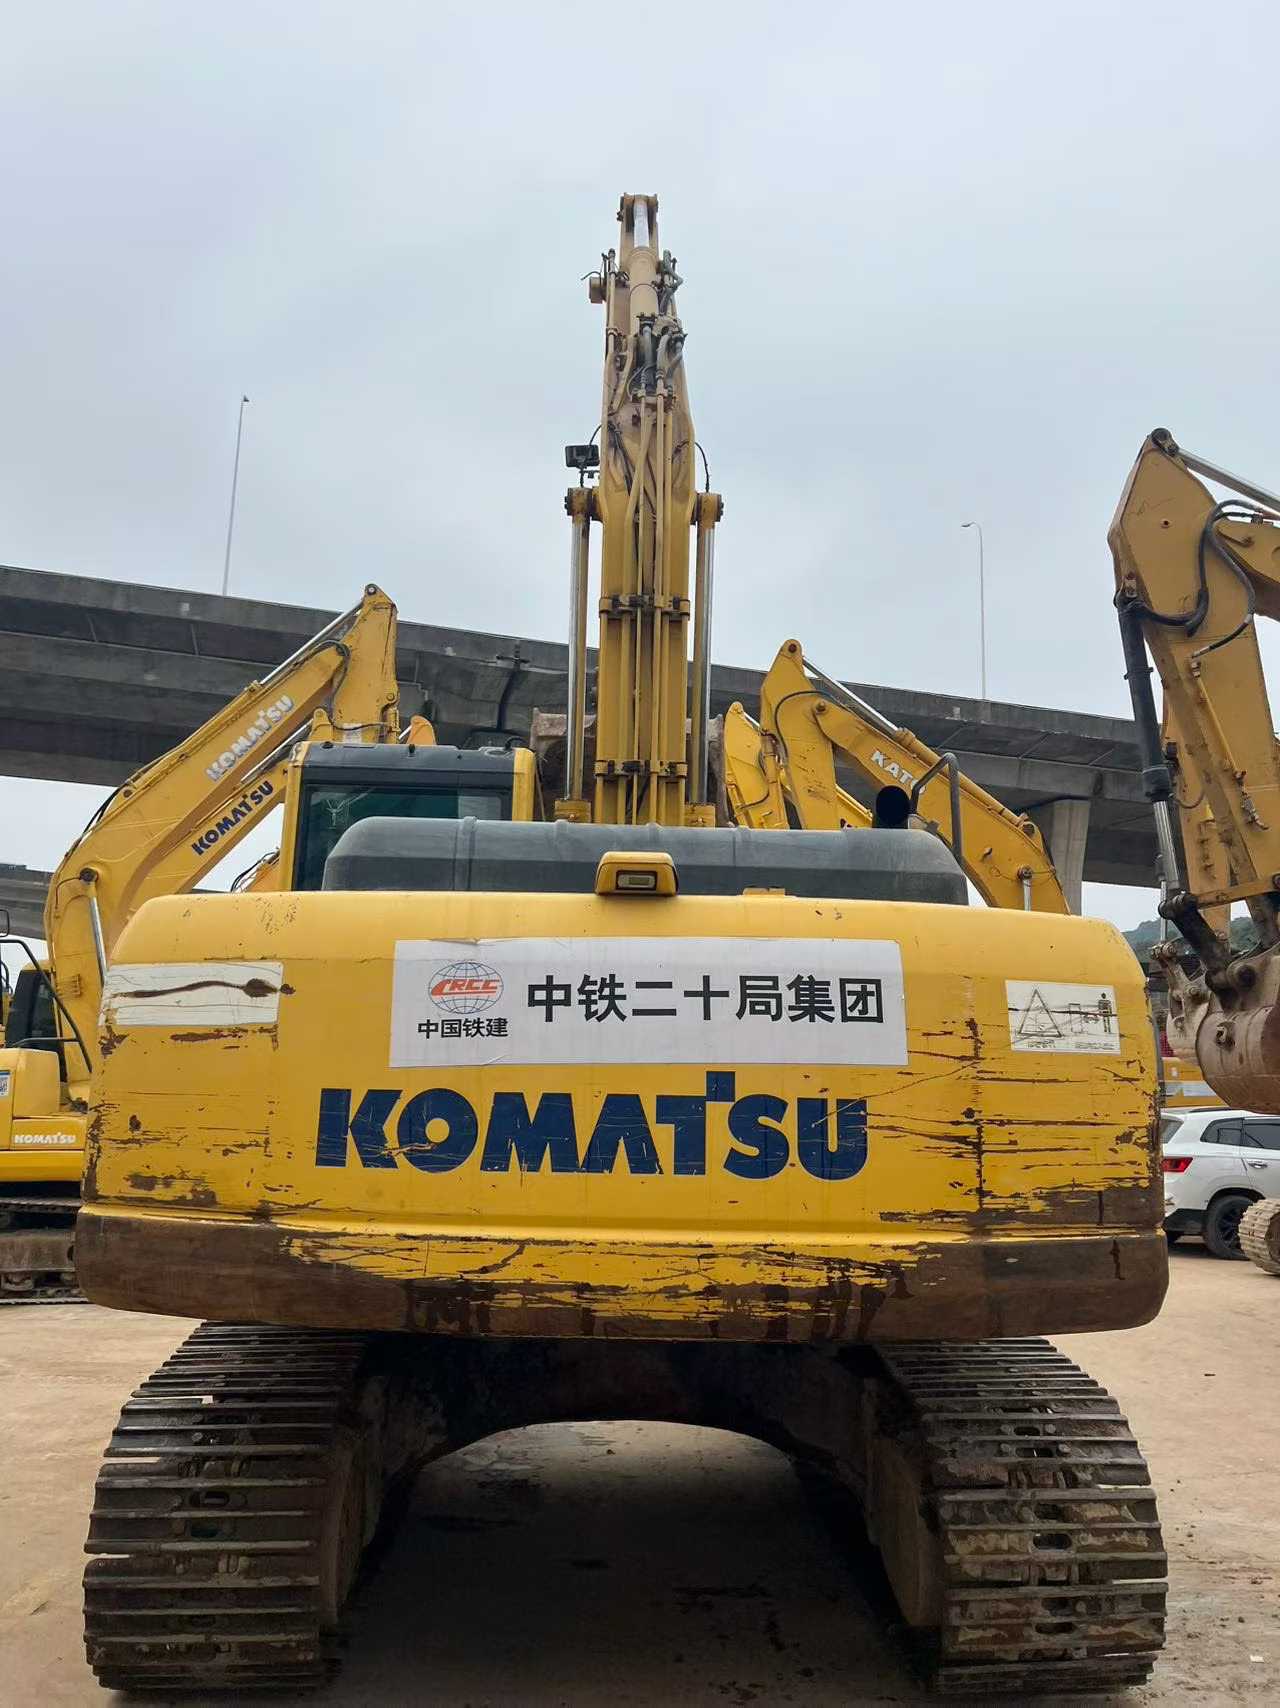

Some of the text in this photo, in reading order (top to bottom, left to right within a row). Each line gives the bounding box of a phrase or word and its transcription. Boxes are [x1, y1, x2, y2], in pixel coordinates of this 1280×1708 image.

[205, 694, 294, 783] KOMATSU
[191, 780, 274, 856] KOMATSU
[417, 1017, 509, 1040] 中国铁建
[527, 973, 884, 1024] 中铁二十局集团
[14, 1131, 76, 1144] KOMATSU
[315, 1071, 868, 1181] KOMATSU
